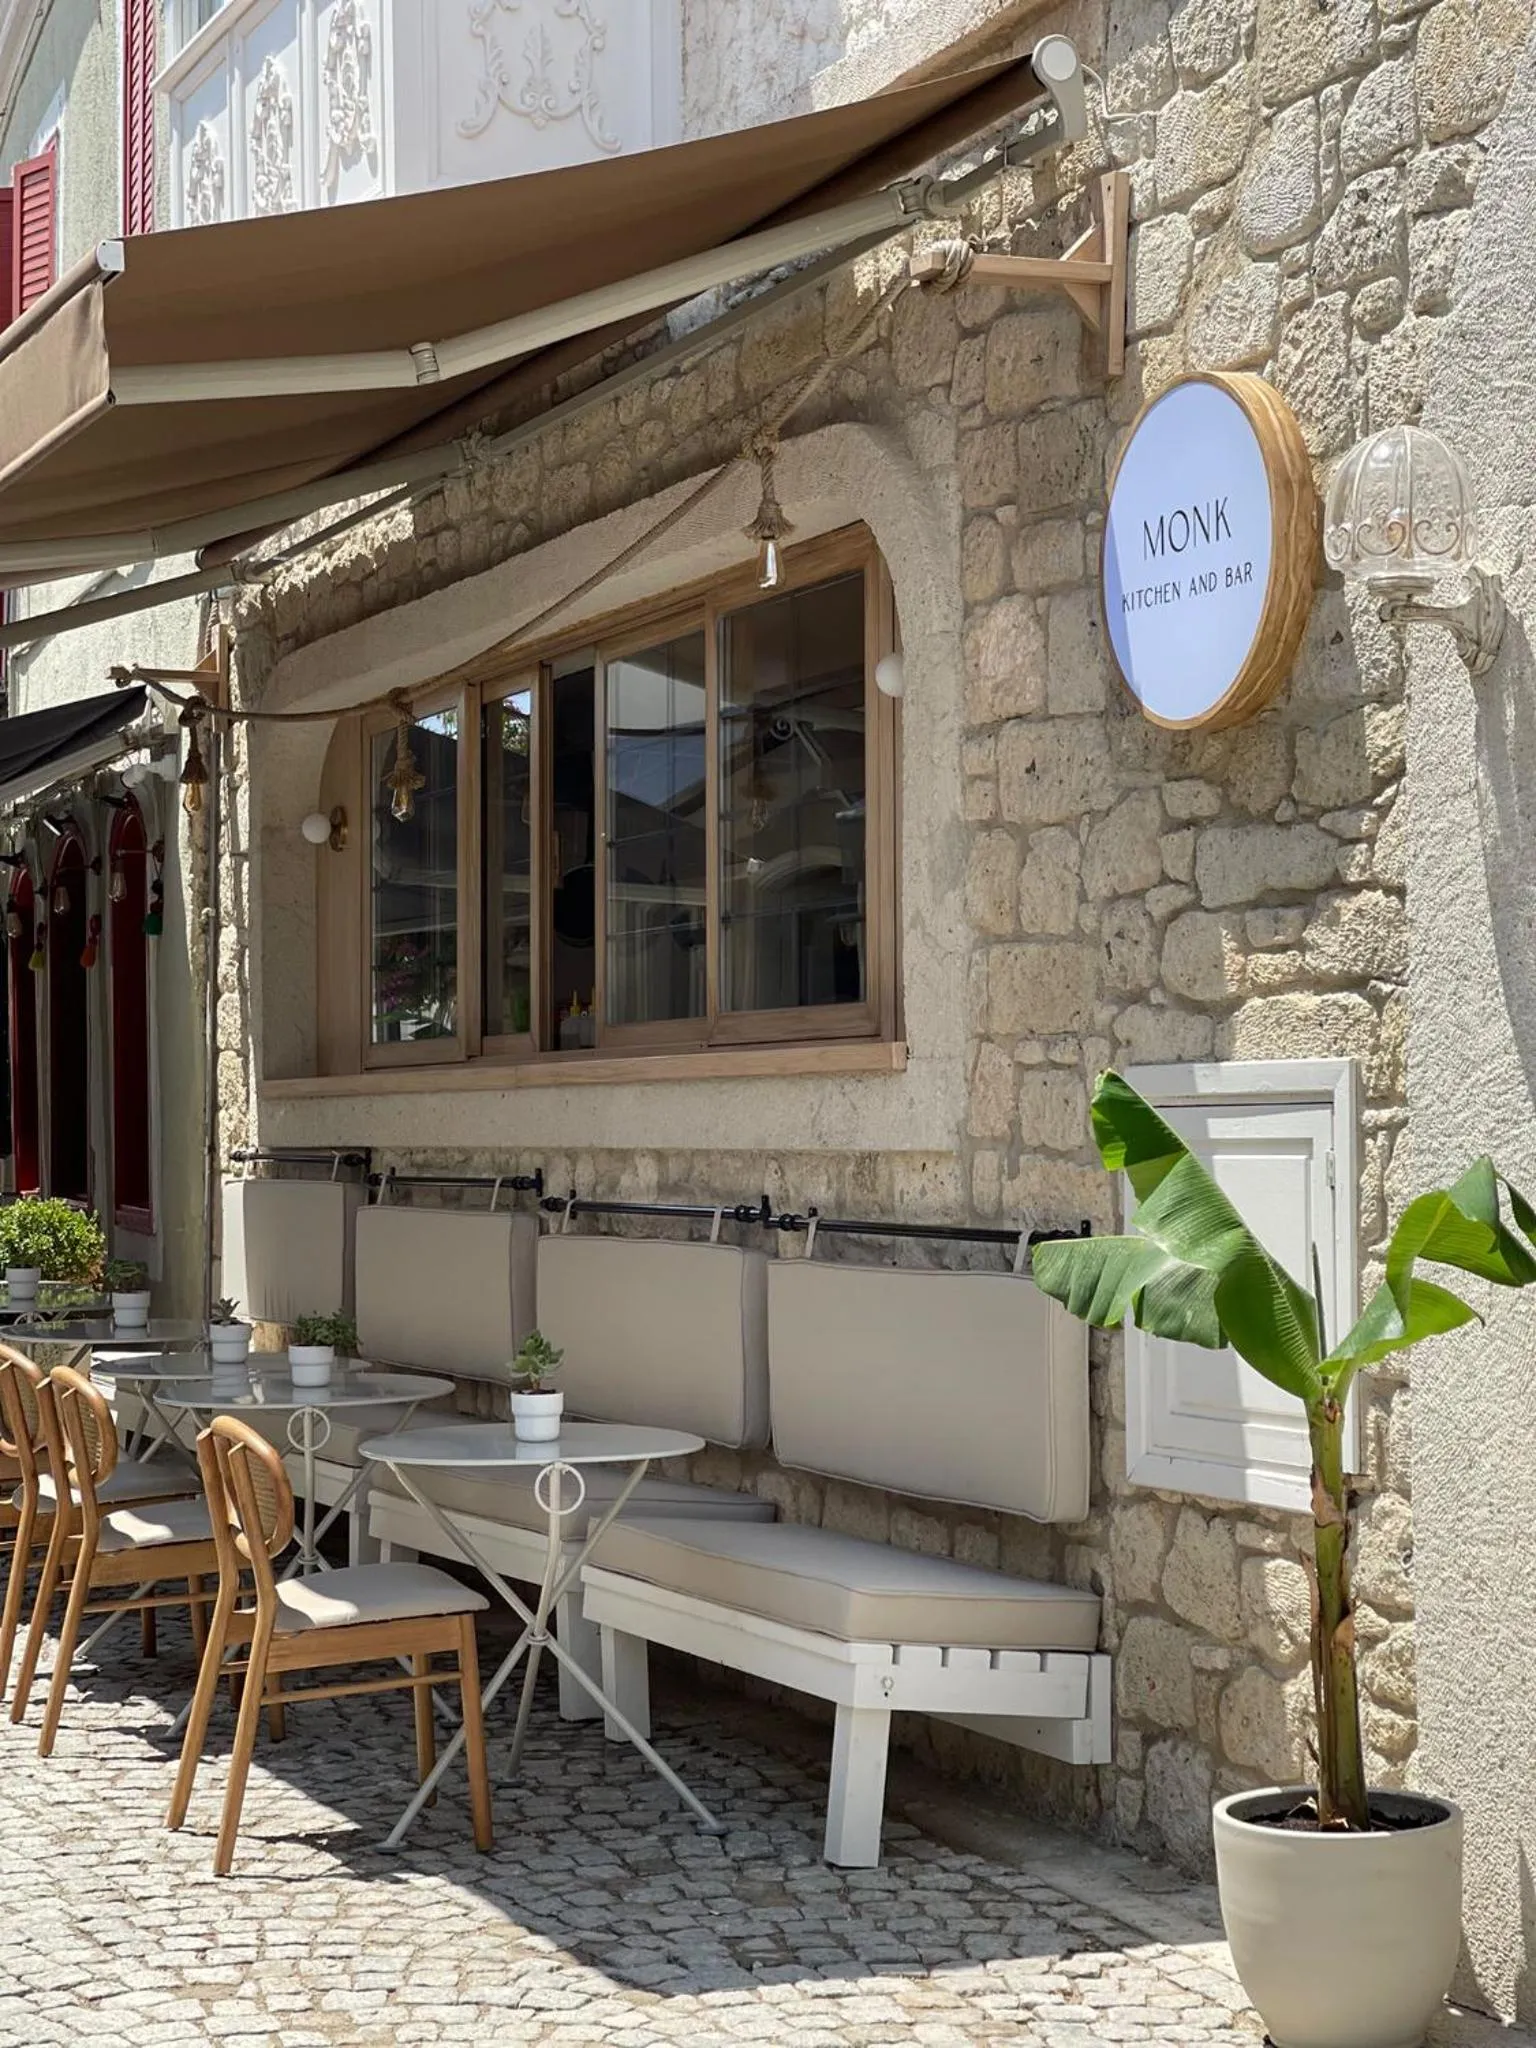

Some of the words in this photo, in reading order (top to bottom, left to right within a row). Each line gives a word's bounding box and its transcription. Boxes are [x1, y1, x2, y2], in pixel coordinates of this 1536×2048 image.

[1143, 497, 1232, 561] MONK
[1121, 580, 1182, 614] KITCHEN
[1189, 571, 1218, 597] AND
[1225, 562, 1253, 588] BAR
